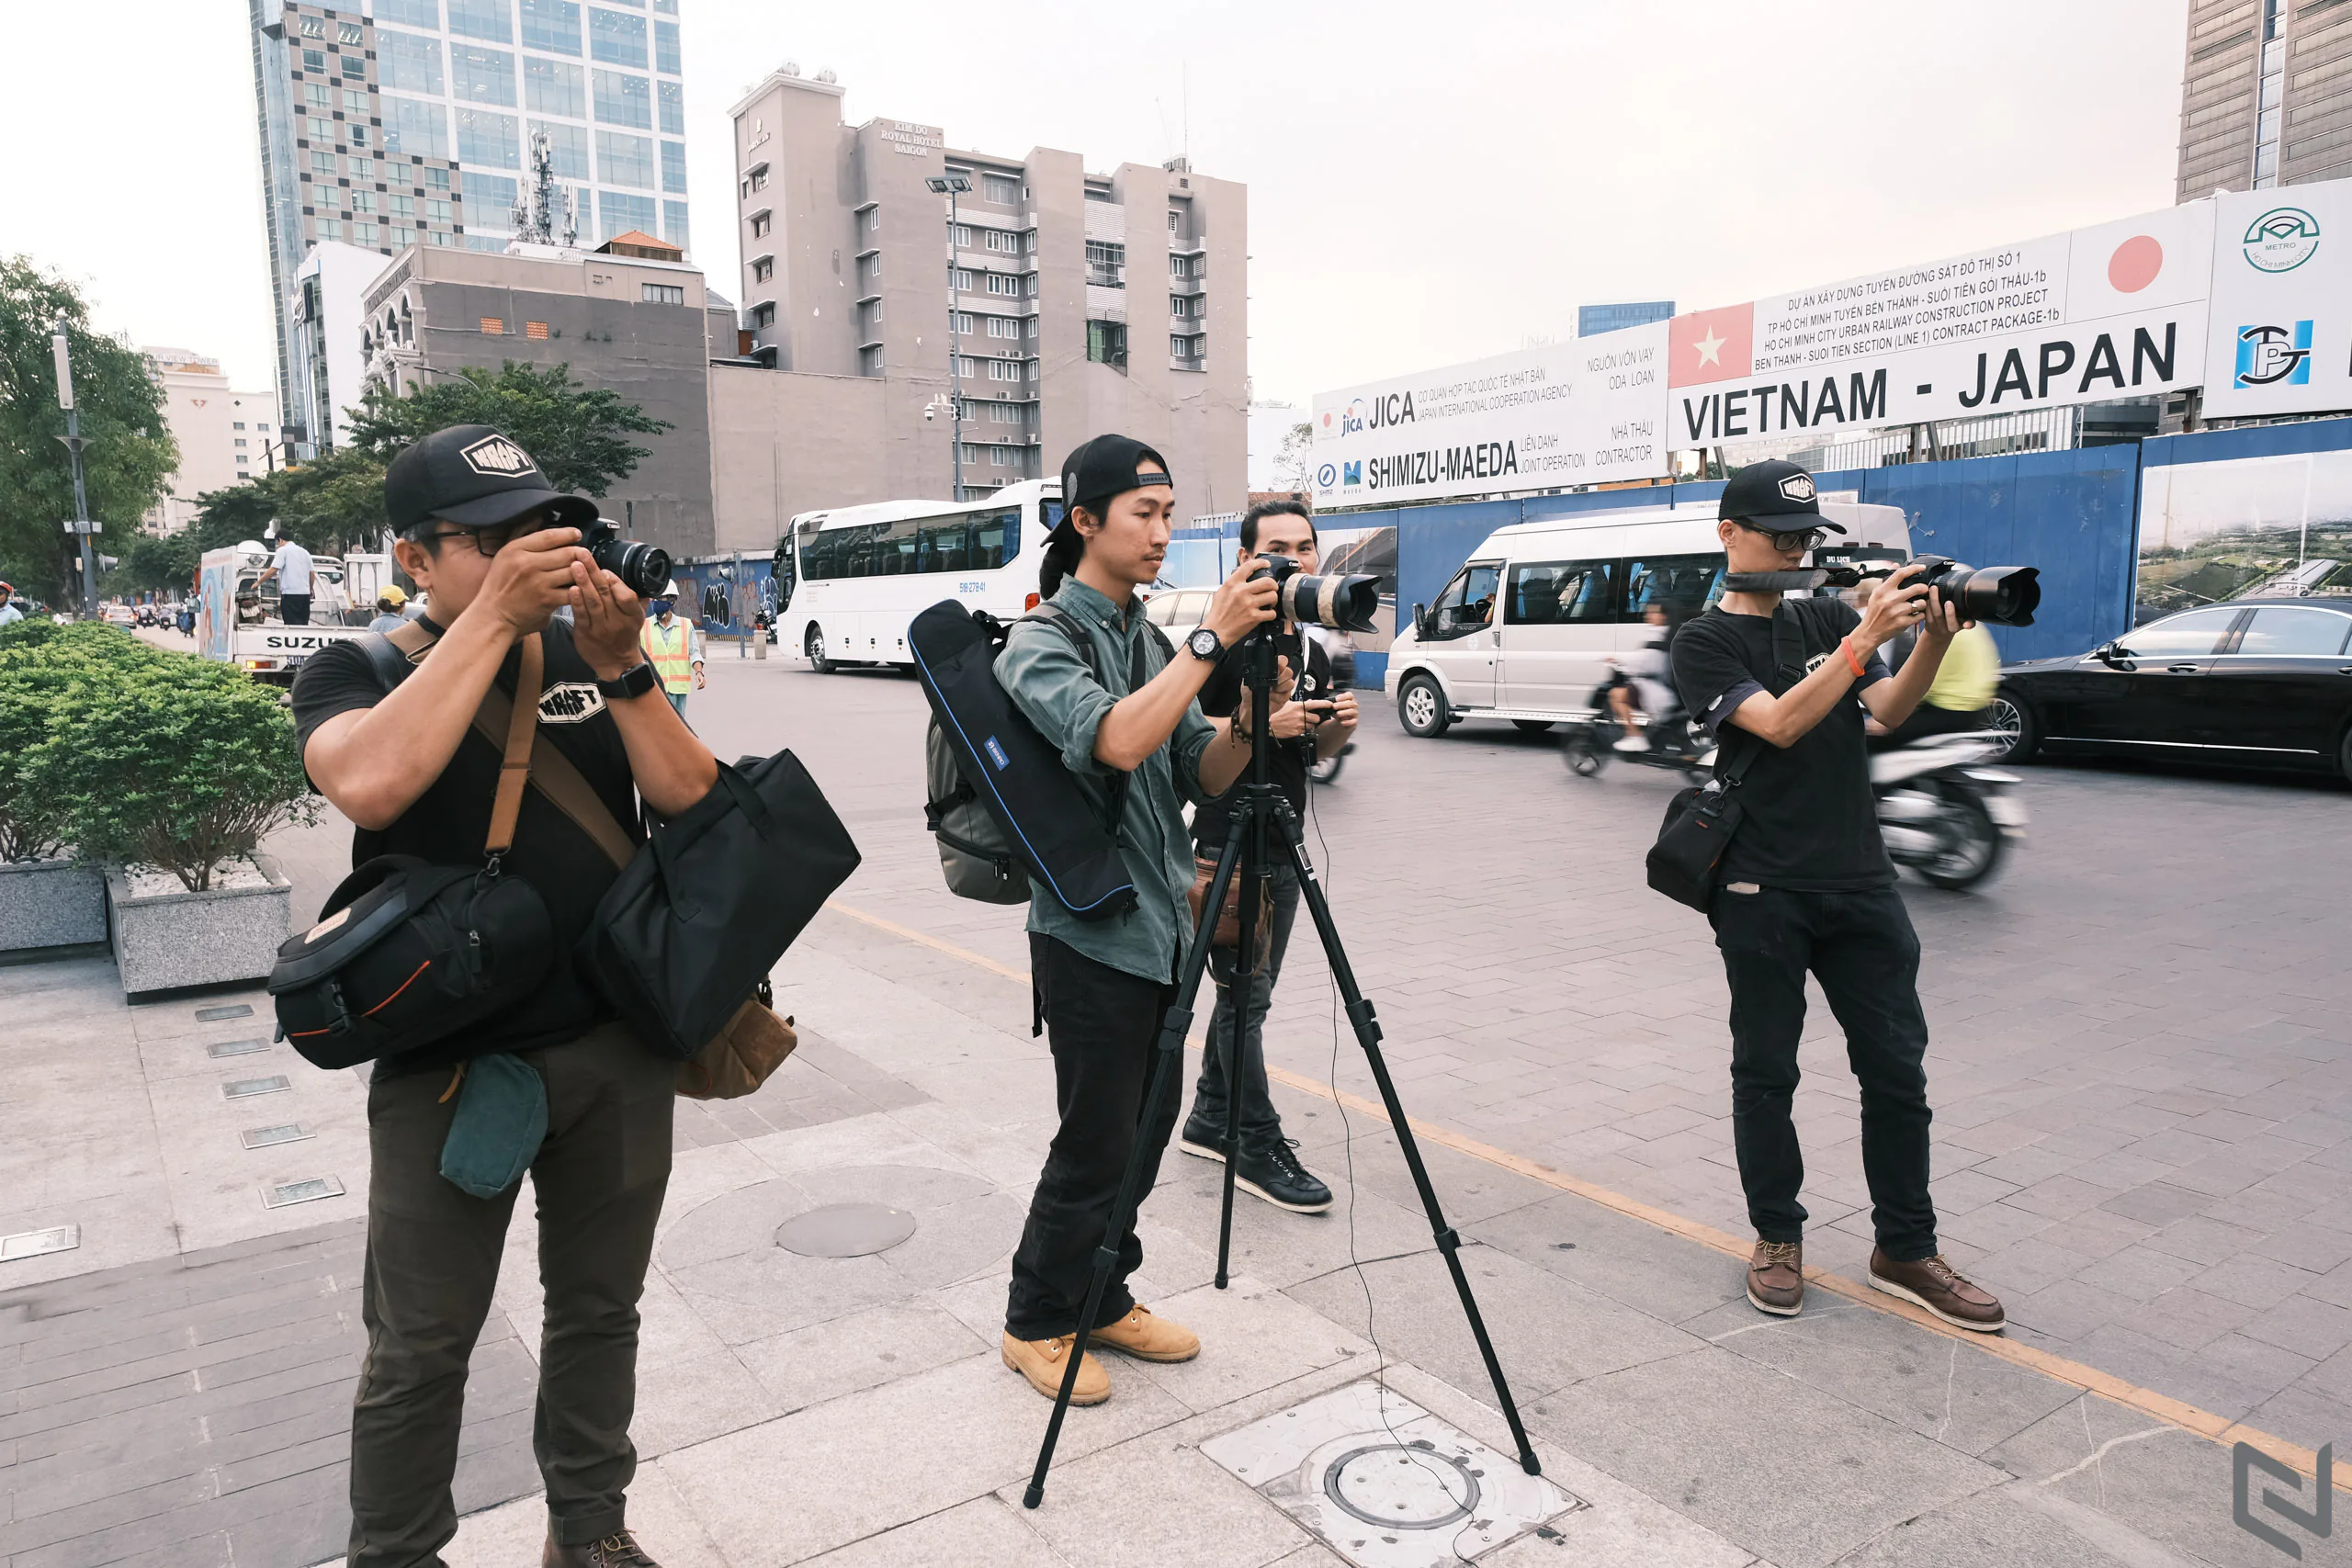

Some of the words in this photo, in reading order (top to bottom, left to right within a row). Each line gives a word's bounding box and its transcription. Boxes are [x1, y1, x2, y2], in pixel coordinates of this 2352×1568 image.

[881, 130, 911, 144] ROYAL
[913, 135, 942, 149] HOTEL
[895, 122, 912, 133] KIM
[915, 125, 928, 136] DO
[895, 143, 928, 157] SAIGON
[2265, 242, 2296, 251] METRO
[1979, 256, 1995, 273] THỊ
[2016, 251, 2020, 264] 1
[1764, 339, 1776, 353] HO
[1778, 335, 1792, 349] CHI
[1794, 332, 1815, 346] MINH
[1817, 328, 1837, 343] CITY
[1838, 322, 1870, 339] URBAN
[1872, 314, 1913, 332] RAILWAY
[1916, 299, 1995, 325] CONSTRUCTION
[1997, 288, 2048, 310] PROJECT
[1768, 321, 1778, 334] TP
[1810, 311, 1831, 327] MINH
[1755, 357, 1771, 370] BEN
[1774, 352, 1802, 367] THANH
[1808, 347, 1829, 362] SUOI
[1831, 344, 1850, 357] TIEN
[1853, 336, 1893, 355] SECTION
[1894, 331, 1918, 350] (LINE
[1922, 330, 1930, 346] 1)
[1932, 319, 1988, 341] CONTRACT
[1991, 308, 2060, 331] PACKAGE-1b
[165, 355, 186, 363] VIEW
[188, 356, 218, 365] TOWER
[1638, 346, 1655, 363] VAY
[1609, 374, 1626, 390] ODA
[1631, 369, 1655, 387] LOAN
[1682, 367, 1888, 441] VIETNAM
[1916, 383, 1932, 395] -
[1958, 321, 2177, 408] JAPAN
[1369, 390, 1416, 430] JICA
[1418, 405, 1437, 422] JAPAN
[1438, 396, 1488, 419] INTERNATIONAL
[1489, 389, 1540, 411] COOPERATION
[1541, 383, 1573, 402] AGENCY
[1538, 434, 1558, 450] DANH
[471, 441, 530, 471] KRAFT
[1368, 440, 1519, 491] SHIMIZU-MAEDA
[1520, 457, 1542, 474] JOINT
[1543, 452, 1586, 471] OPERATION
[1595, 445, 1653, 466] CONTRACTOR
[1783, 478, 1815, 499] KRAFT
[266, 636, 334, 649] SUZU
[538, 689, 597, 716] KRAFT
